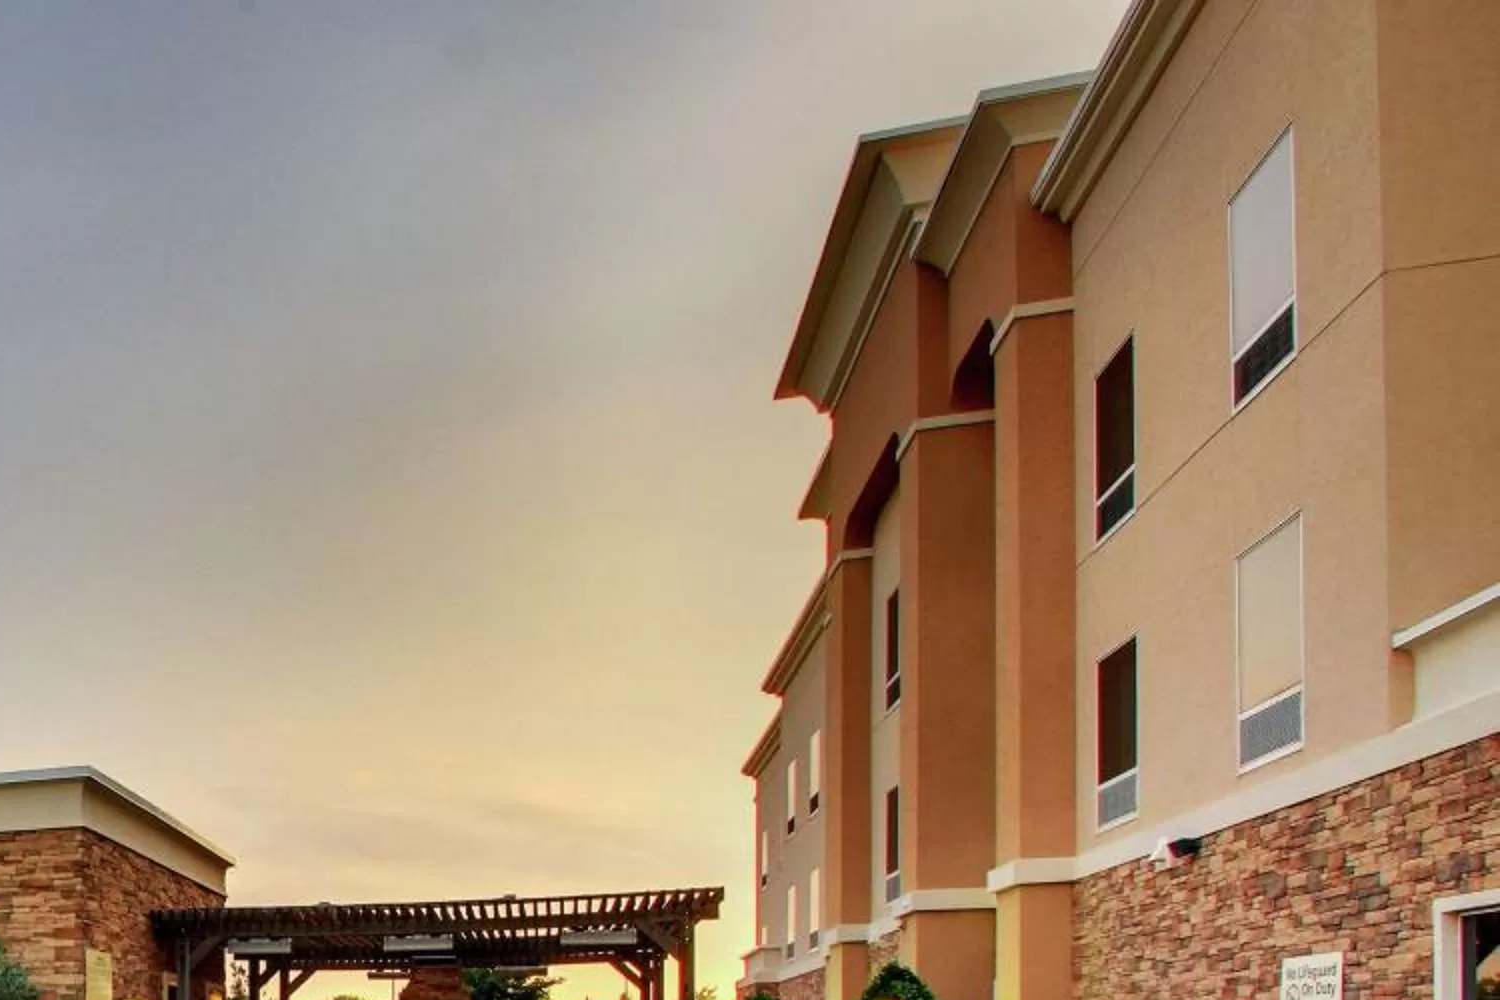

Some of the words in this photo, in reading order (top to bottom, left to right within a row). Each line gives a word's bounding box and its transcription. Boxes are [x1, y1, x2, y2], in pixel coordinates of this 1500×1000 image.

[1286, 967, 1296, 980] No
[1298, 962, 1337, 981] Lifeguard
[1301, 983, 1313, 995] On
[1316, 981, 1336, 998] Duty
